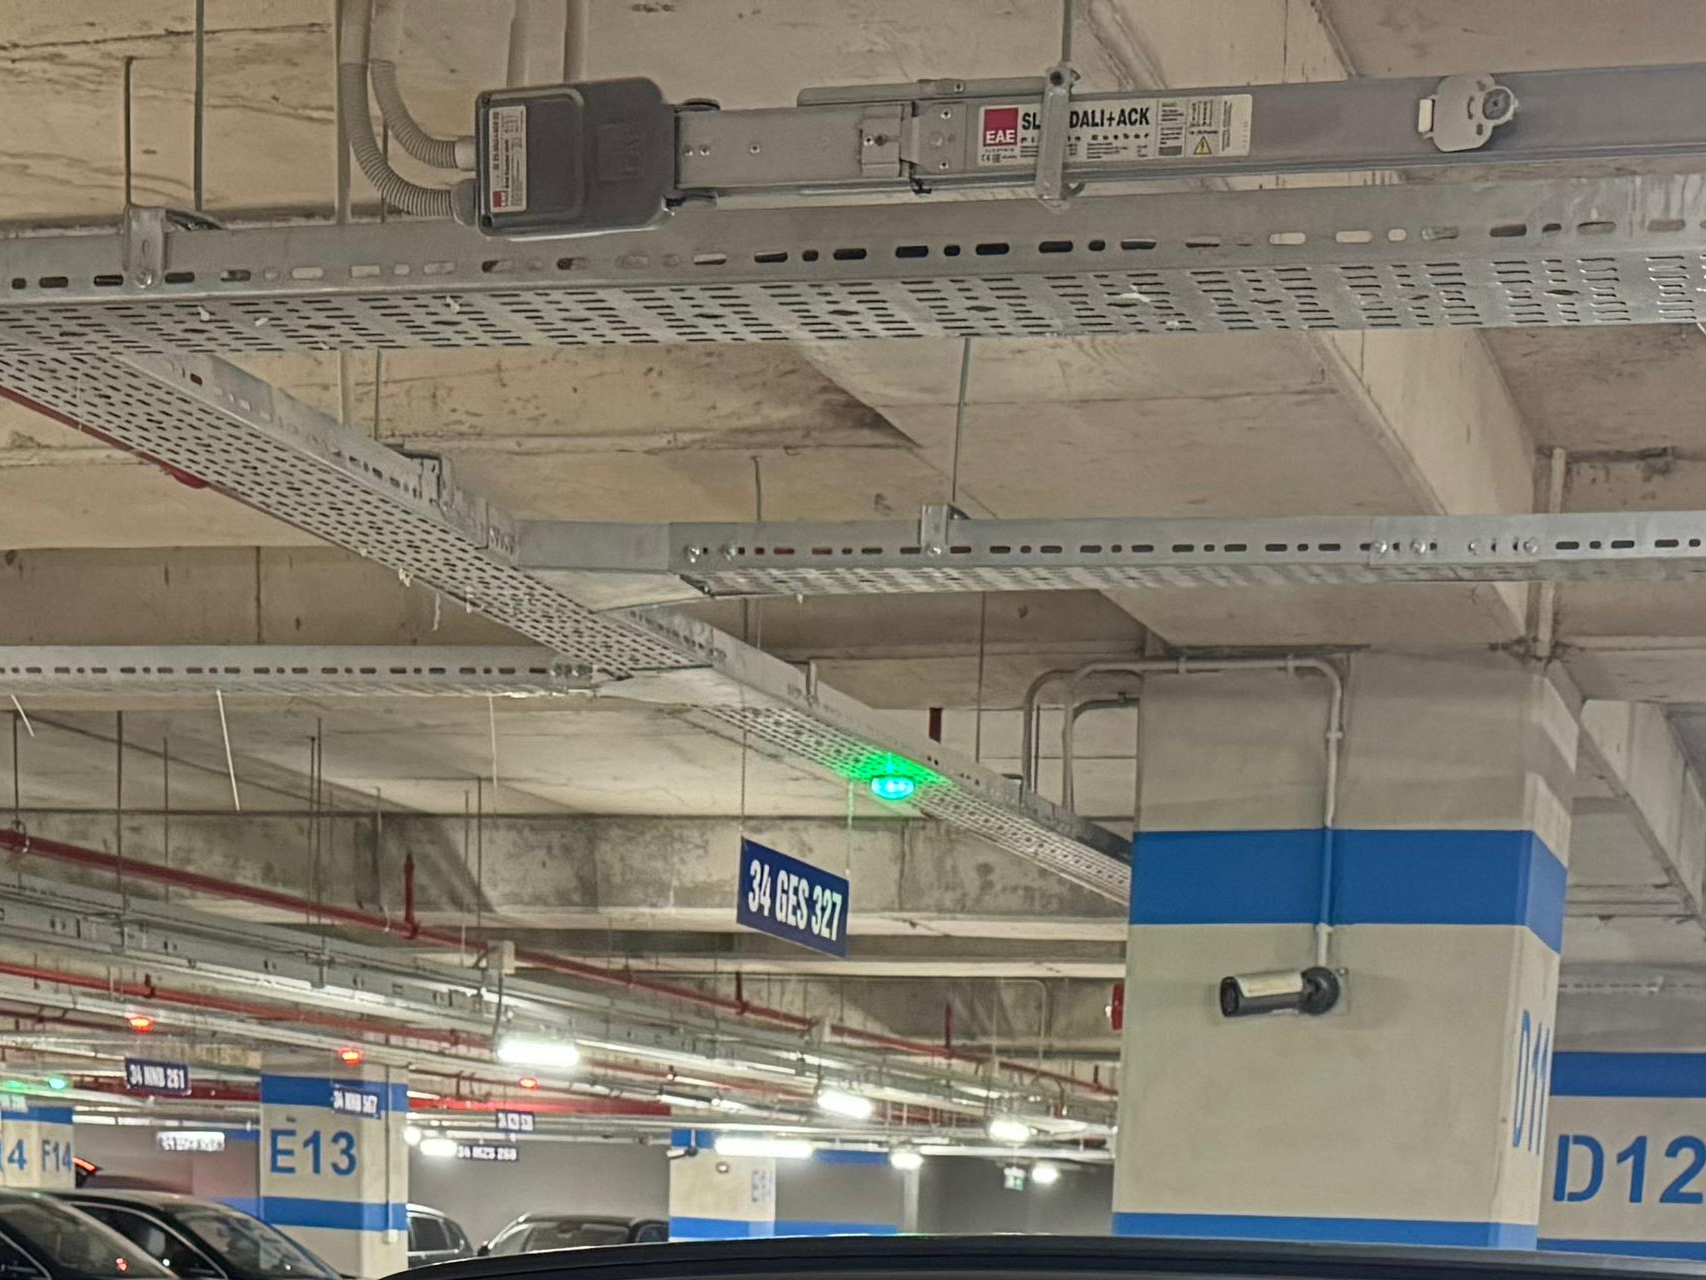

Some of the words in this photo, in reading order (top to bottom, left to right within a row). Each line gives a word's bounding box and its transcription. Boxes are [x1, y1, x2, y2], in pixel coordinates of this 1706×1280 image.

[1069, 107, 1150, 128] DALI+ACK
[986, 129, 1016, 144] EAE
[748, 859, 771, 917] 34
[775, 870, 809, 930] GES
[811, 885, 842, 941] 327
[43, 1139, 72, 1172] F14
[270, 1128, 357, 1176] E13
